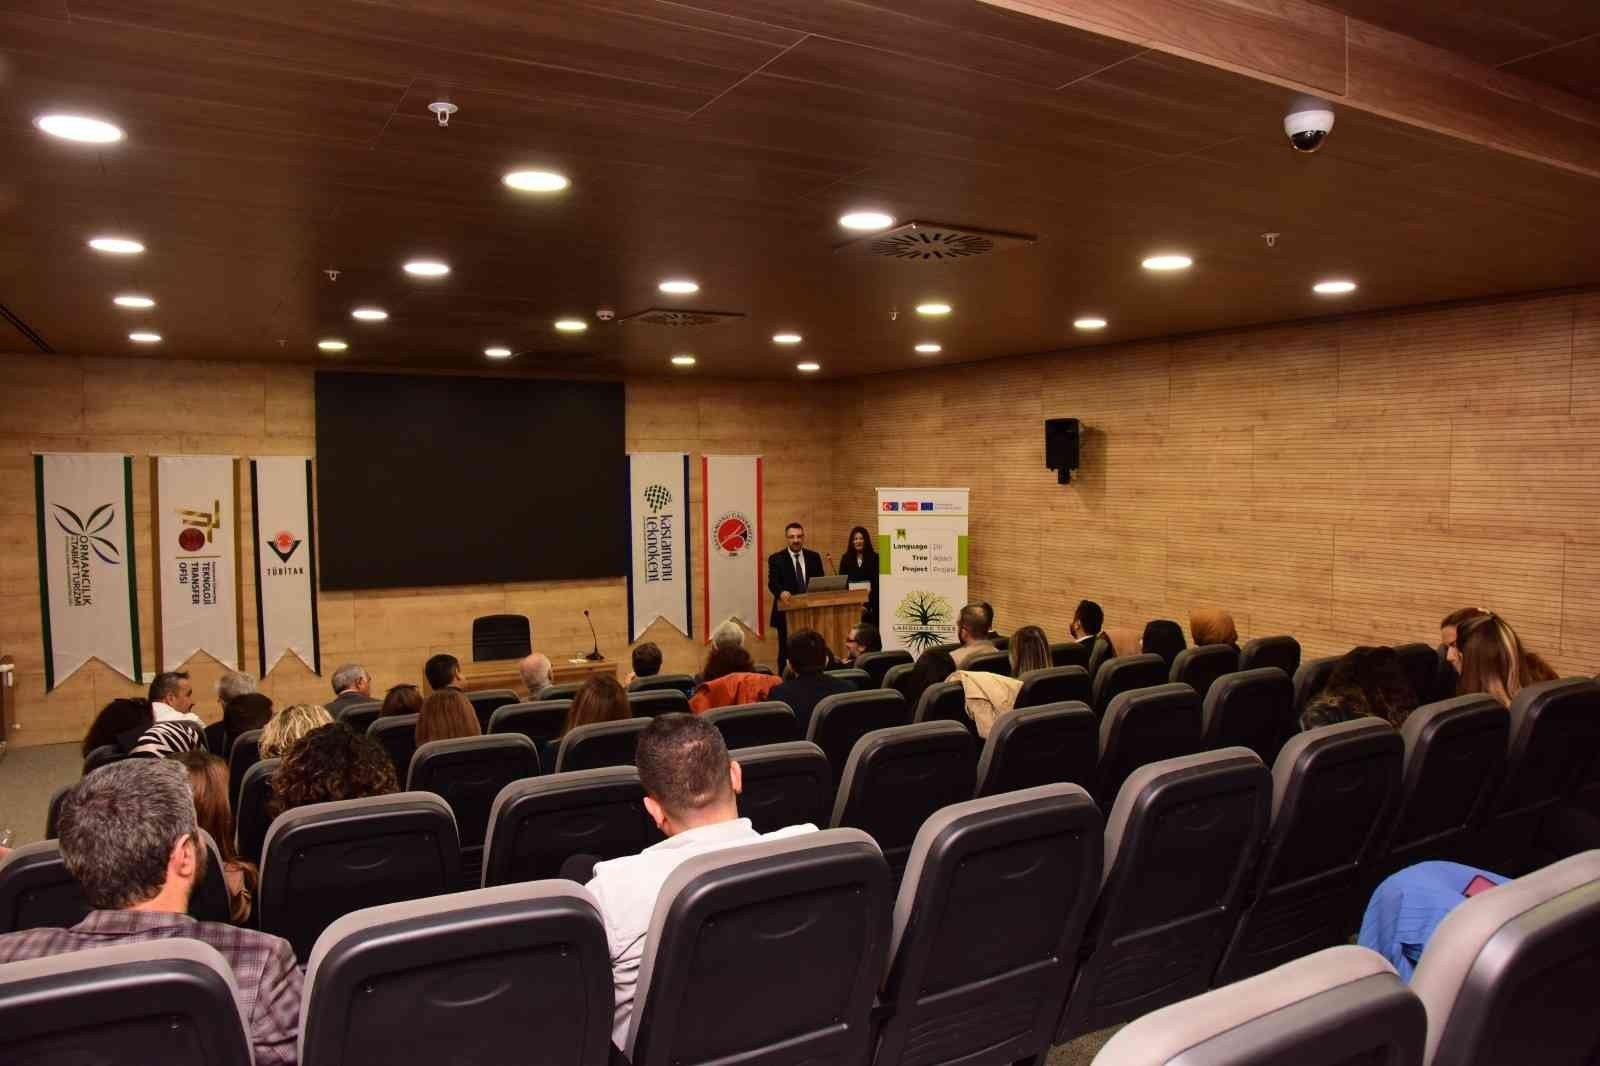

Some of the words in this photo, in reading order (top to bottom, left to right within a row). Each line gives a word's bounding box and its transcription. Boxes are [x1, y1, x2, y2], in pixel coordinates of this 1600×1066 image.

[79, 535, 92, 606] ORMANCILIK
[647, 516, 660, 583] teknokent
[660, 514, 673, 582] kastamonu
[893, 543, 928, 551] Language
[902, 565, 928, 573] Project
[192, 561, 200, 605] TRANSFER
